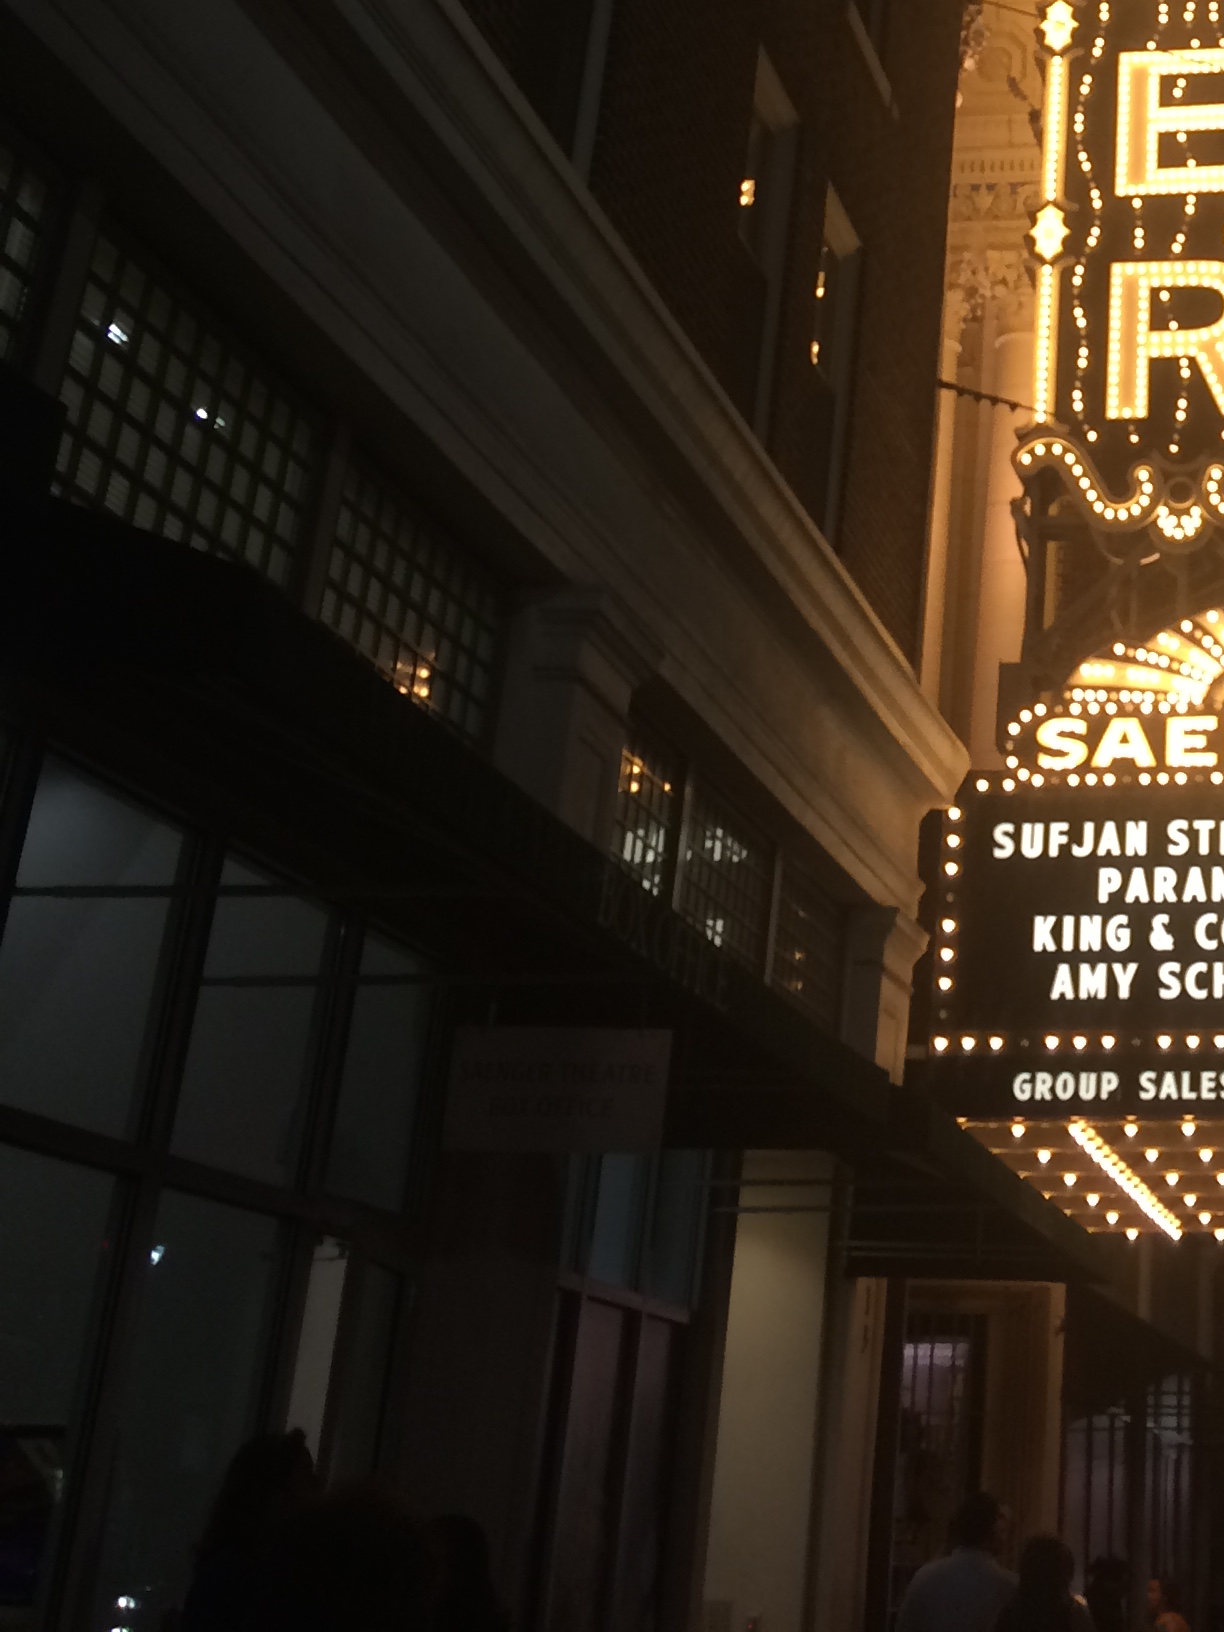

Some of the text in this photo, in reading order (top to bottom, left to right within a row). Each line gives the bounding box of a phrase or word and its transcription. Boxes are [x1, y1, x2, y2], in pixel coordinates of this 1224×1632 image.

[993, 820, 1148, 859] SUFJAN
[1033, 914, 1131, 952] KING
[1149, 914, 1174, 951] &
[1050, 963, 1138, 1000] AMY
[1013, 1072, 1119, 1101] GROUP
